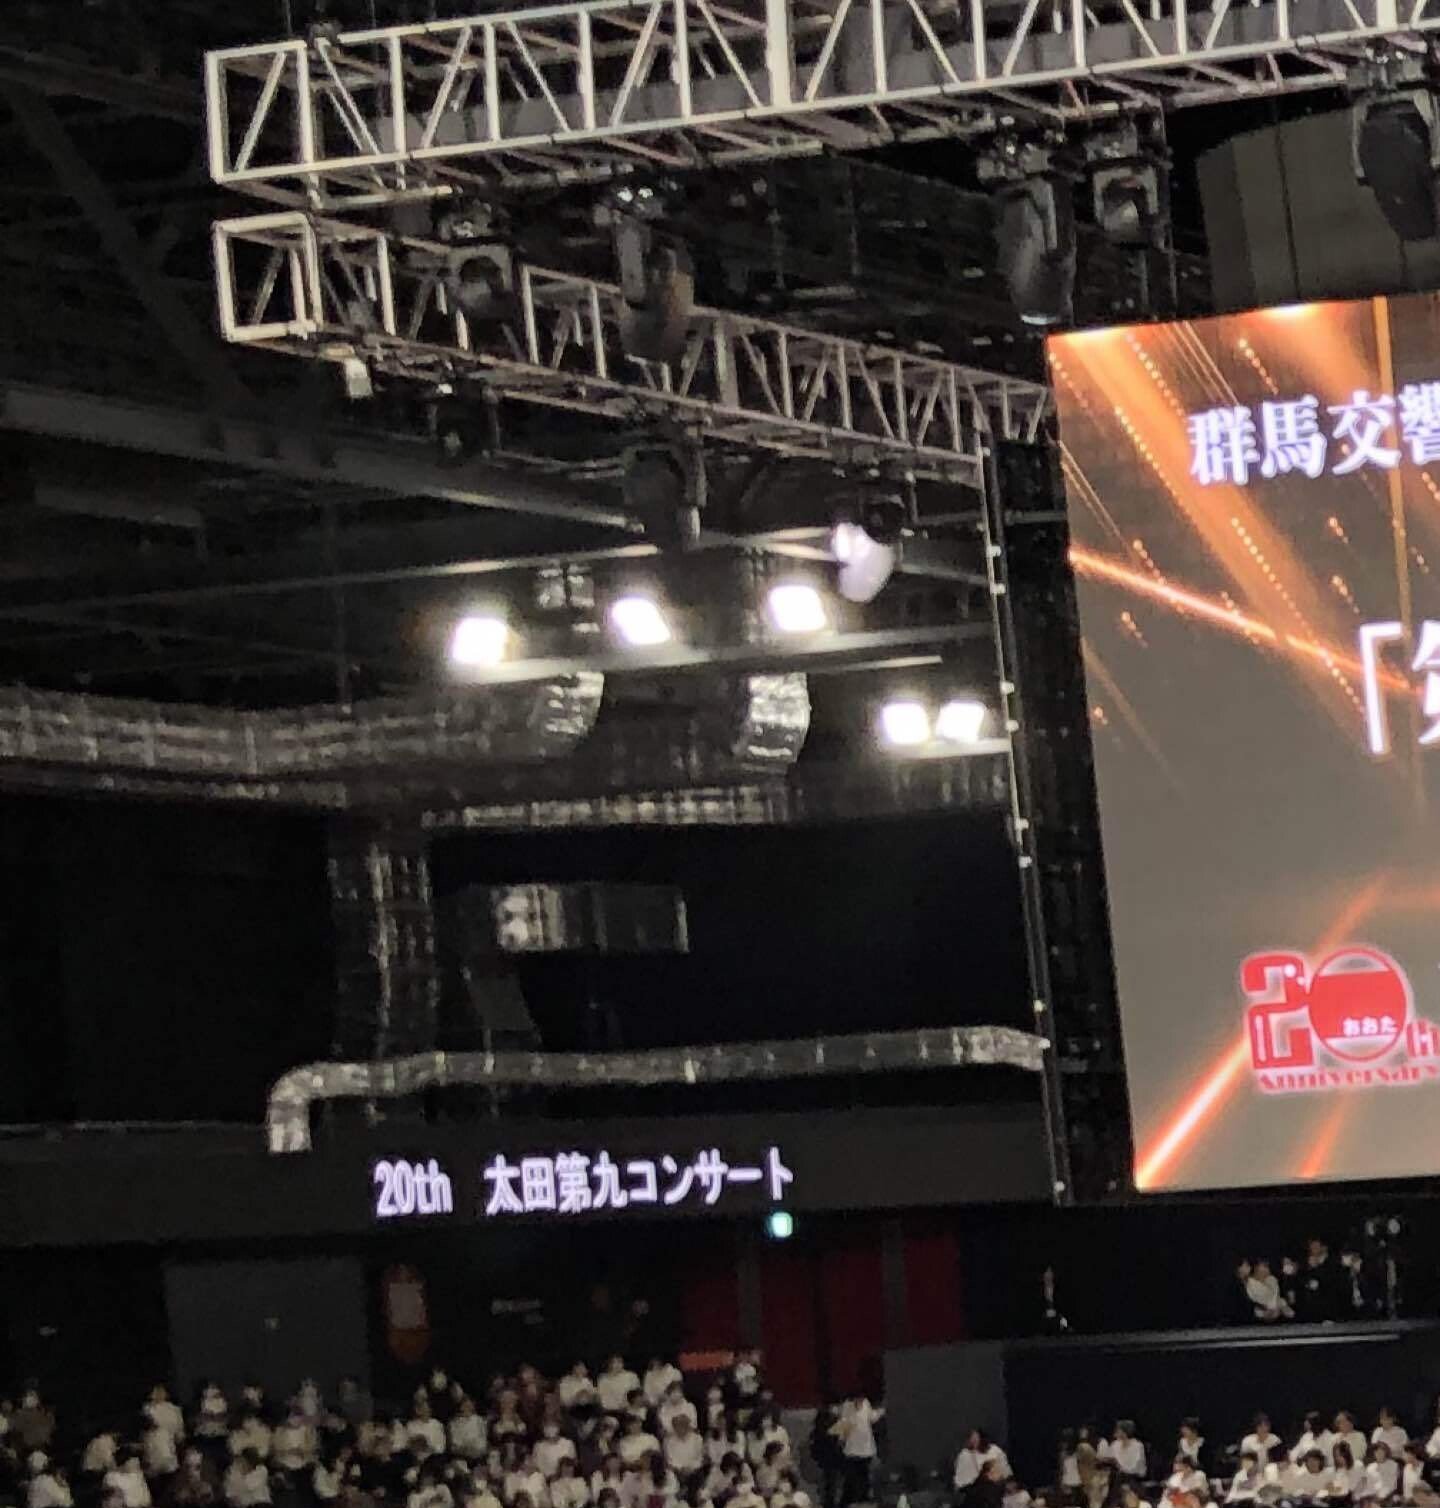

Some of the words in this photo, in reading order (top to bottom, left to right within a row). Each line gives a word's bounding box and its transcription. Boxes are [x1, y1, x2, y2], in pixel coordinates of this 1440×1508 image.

[374, 1158, 453, 1217] 20th
[484, 1147, 793, 1216] 太田第九コンサート
